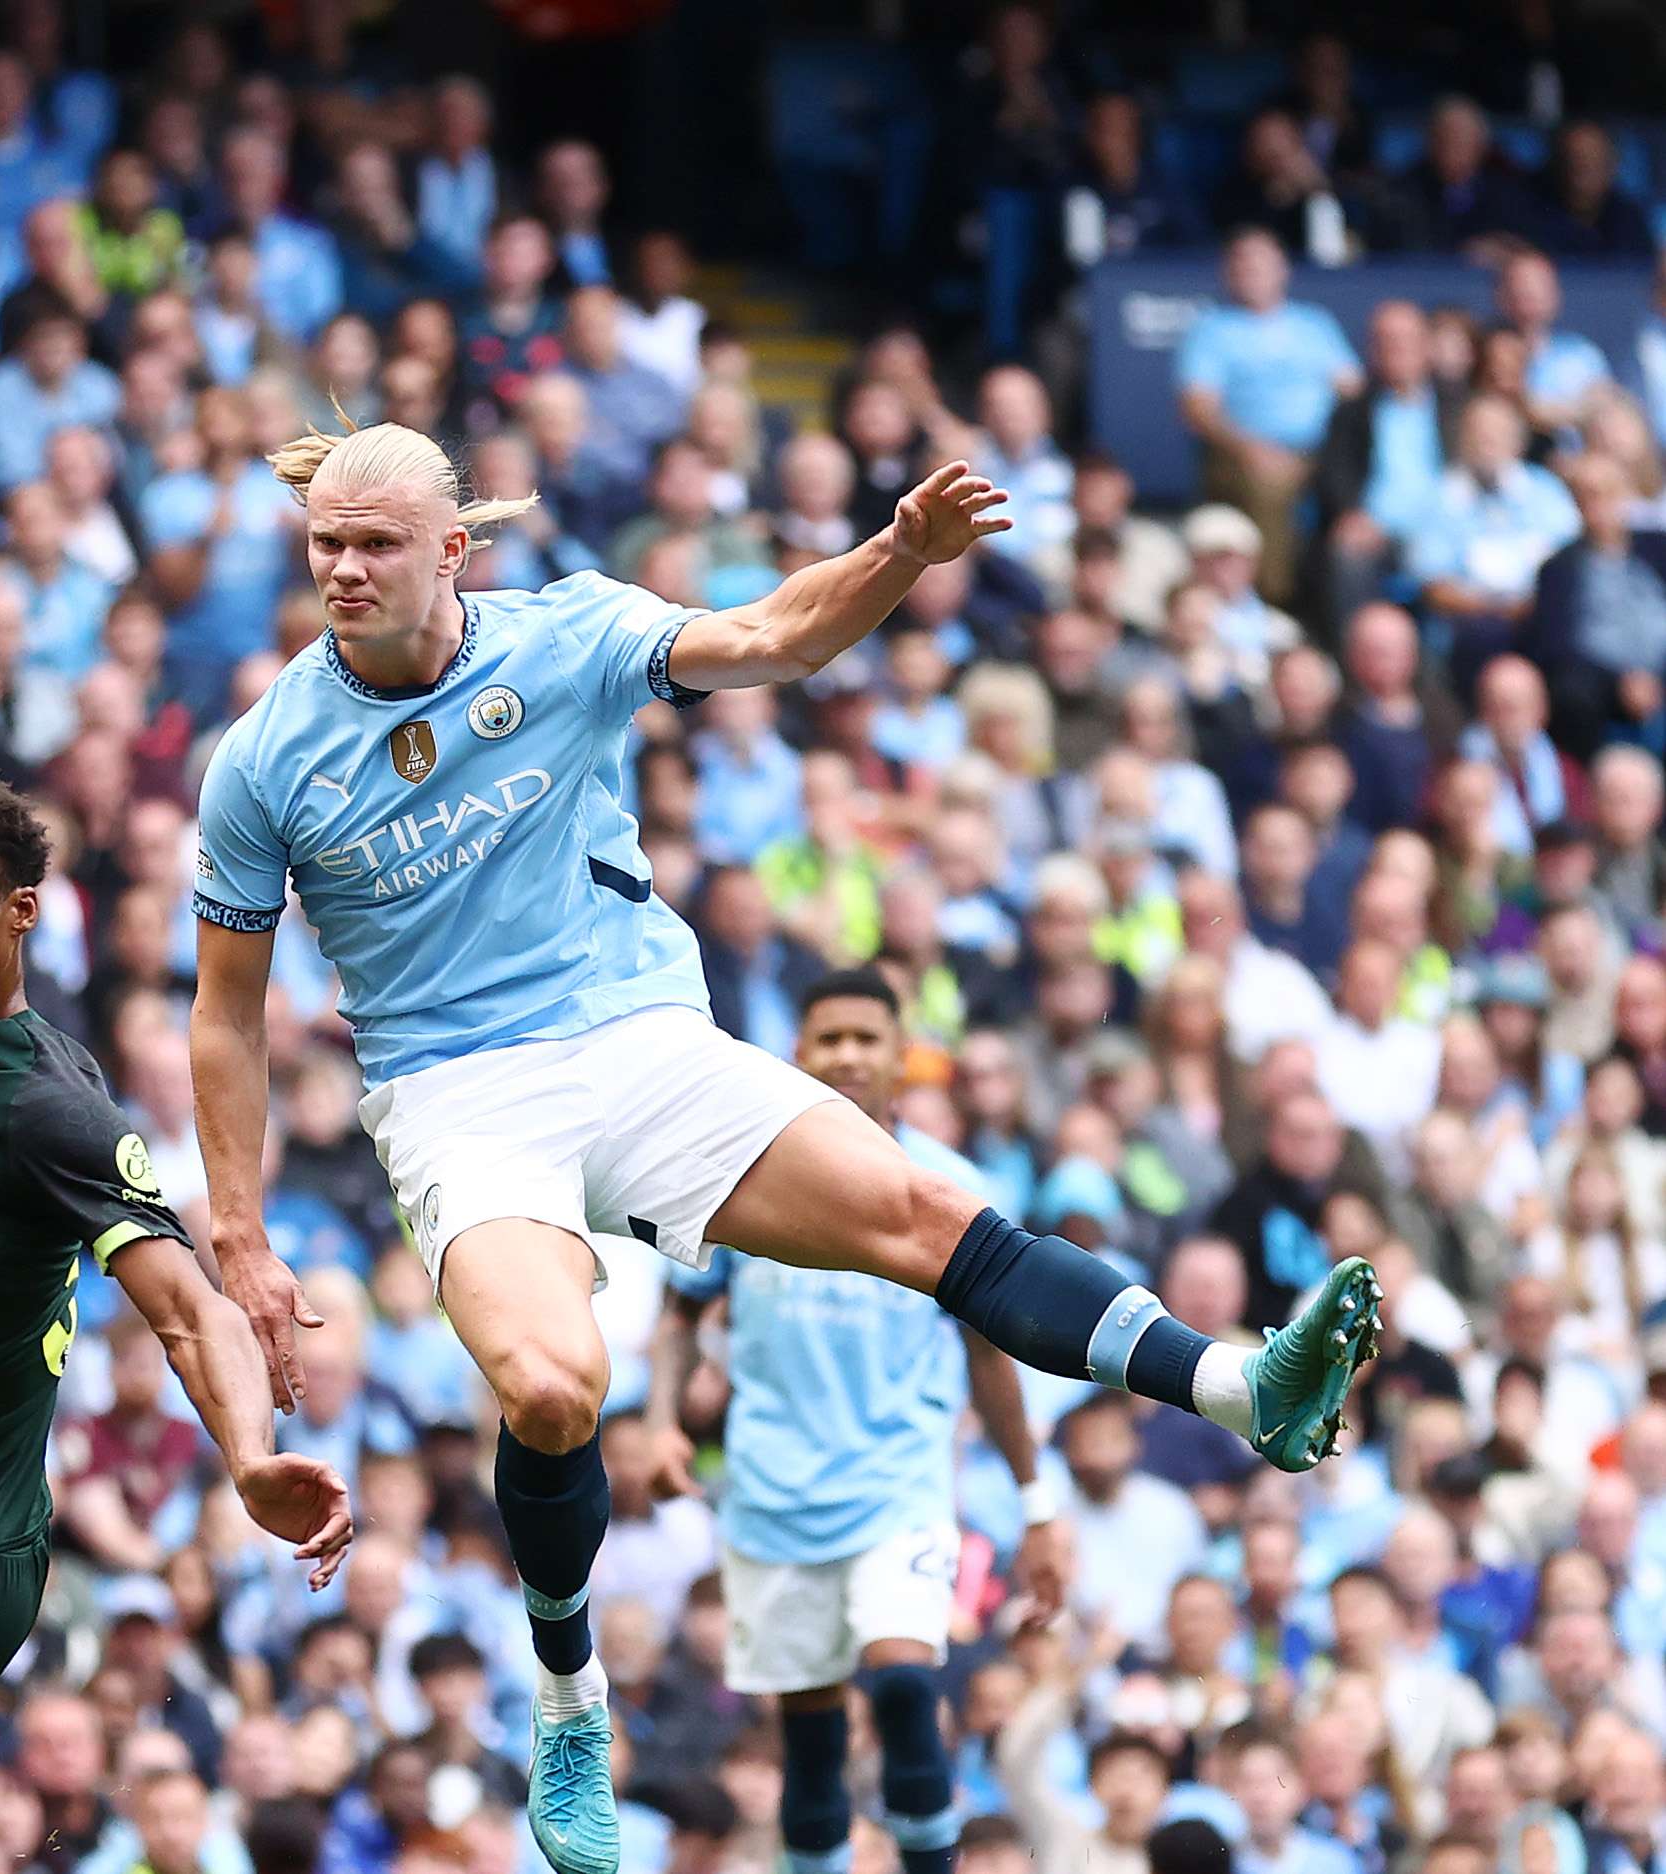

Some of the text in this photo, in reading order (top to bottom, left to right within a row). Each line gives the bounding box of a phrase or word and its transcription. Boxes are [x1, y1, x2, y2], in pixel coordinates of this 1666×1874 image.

[493, 727, 511, 737] CITY
[406, 759, 427, 772] FIFA
[315, 768, 553, 877] ETIHAD
[374, 830, 505, 898] AIRWAYS
